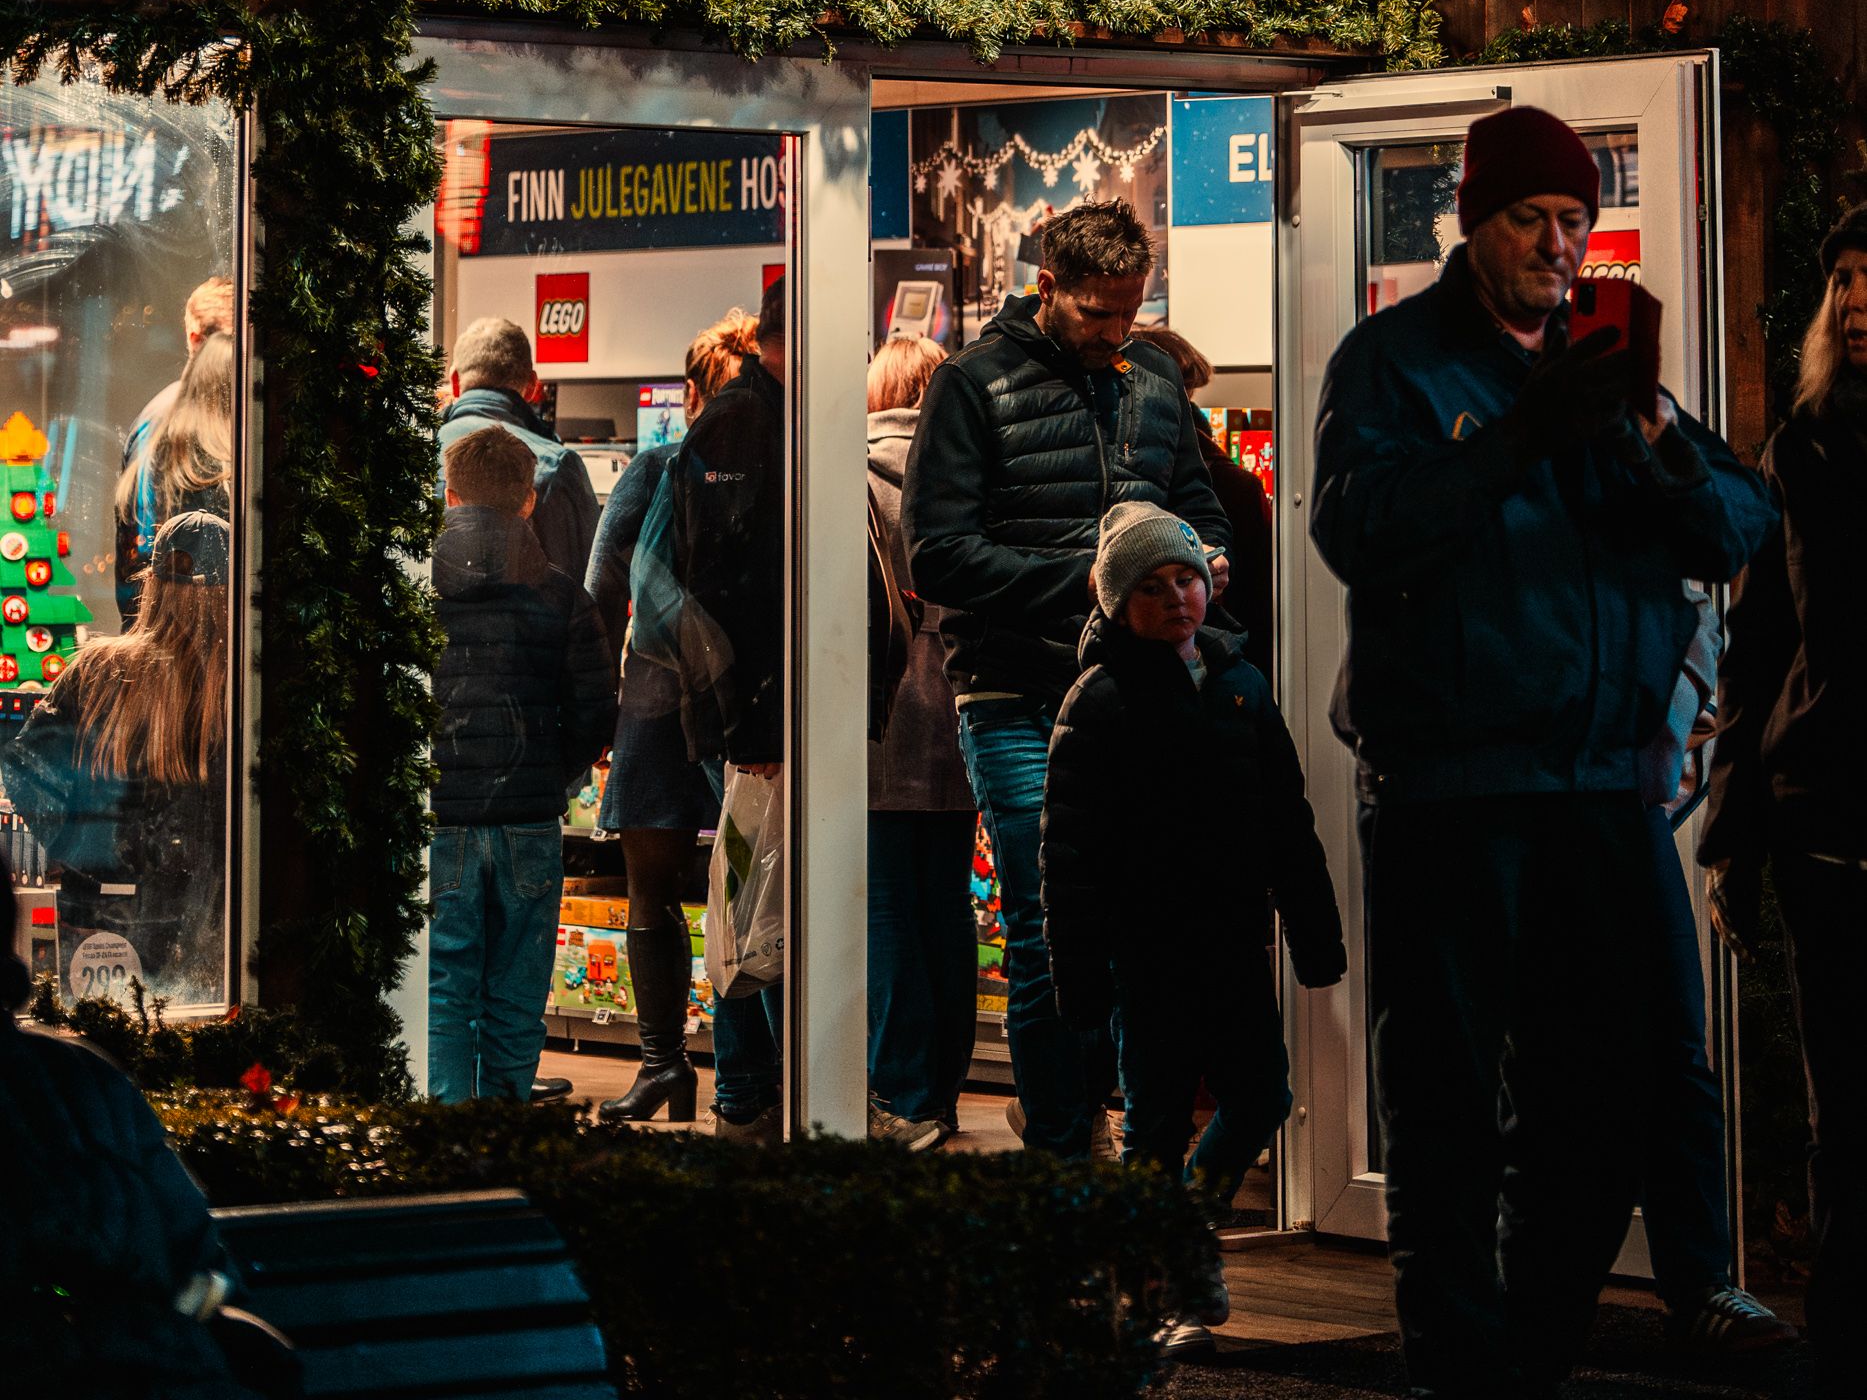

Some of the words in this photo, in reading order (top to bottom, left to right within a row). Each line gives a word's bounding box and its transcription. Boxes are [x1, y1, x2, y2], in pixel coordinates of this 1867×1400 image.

[507, 168, 564, 223] FINN
[570, 158, 733, 220] JULEGAVENE
[538, 299, 586, 337] LEGO
